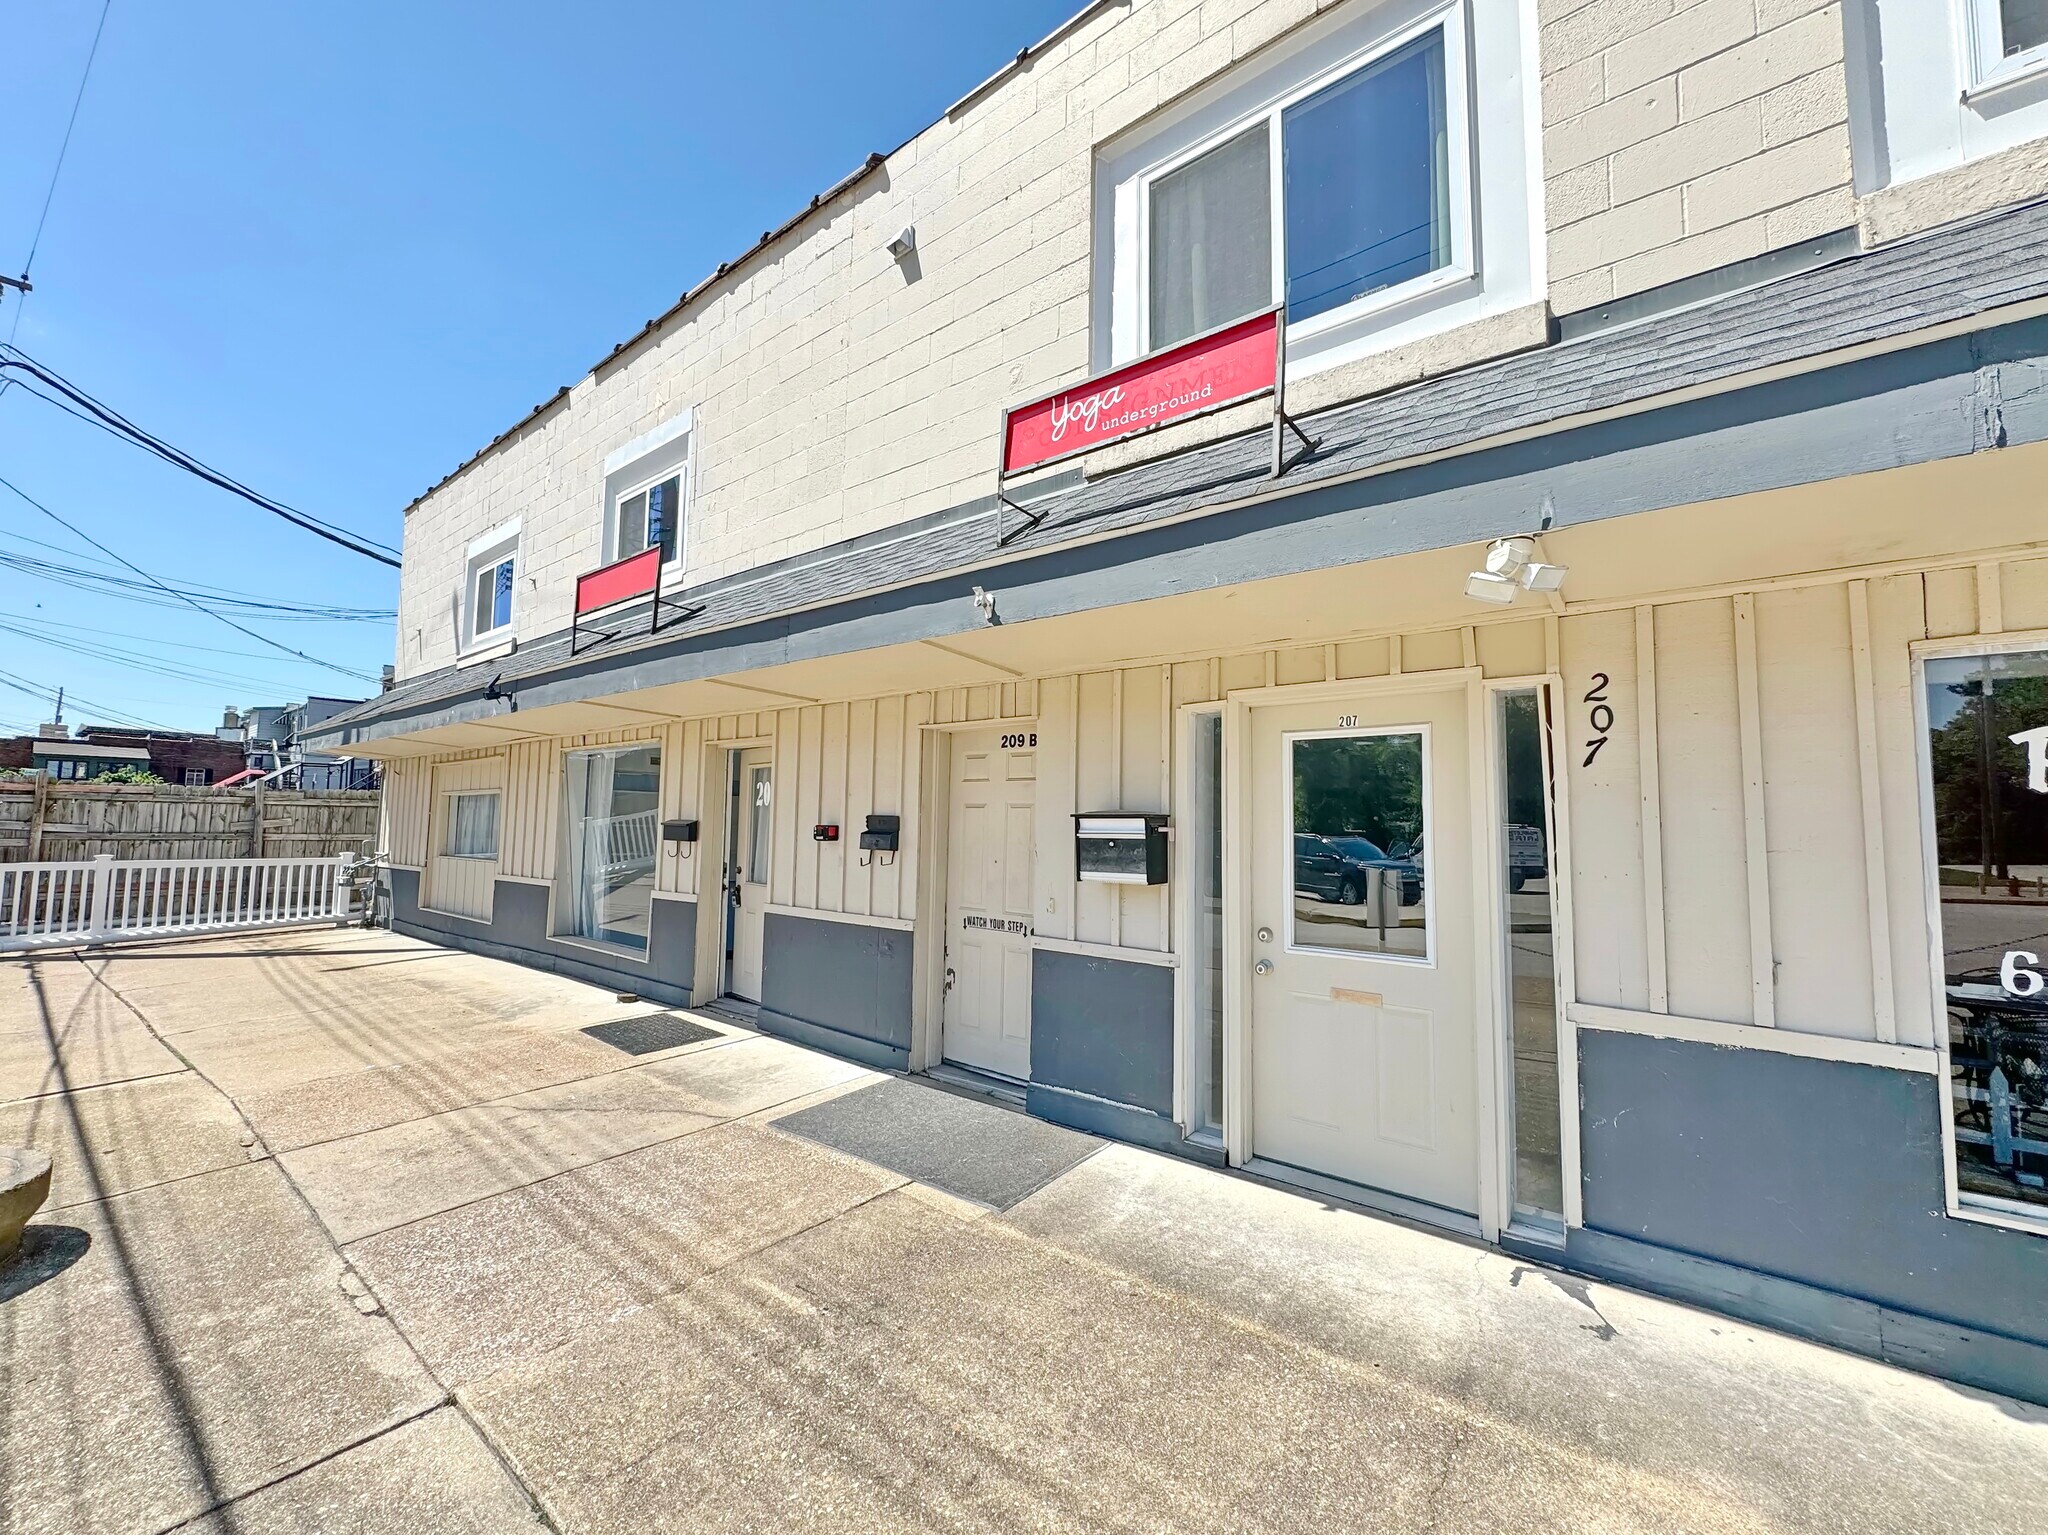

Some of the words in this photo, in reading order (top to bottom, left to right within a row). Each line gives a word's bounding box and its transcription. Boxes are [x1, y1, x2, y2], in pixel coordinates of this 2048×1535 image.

[1101, 383, 1213, 431] underground
[1339, 715, 1358, 728] 207
[1583, 672, 1614, 768] 207
[1001, 733, 1025, 748] 209
[1029, 733, 1038, 747] B
[966, 915, 988, 928] WATCH
[989, 918, 1006, 930] YOUR
[1007, 920, 1024, 932] STEP
